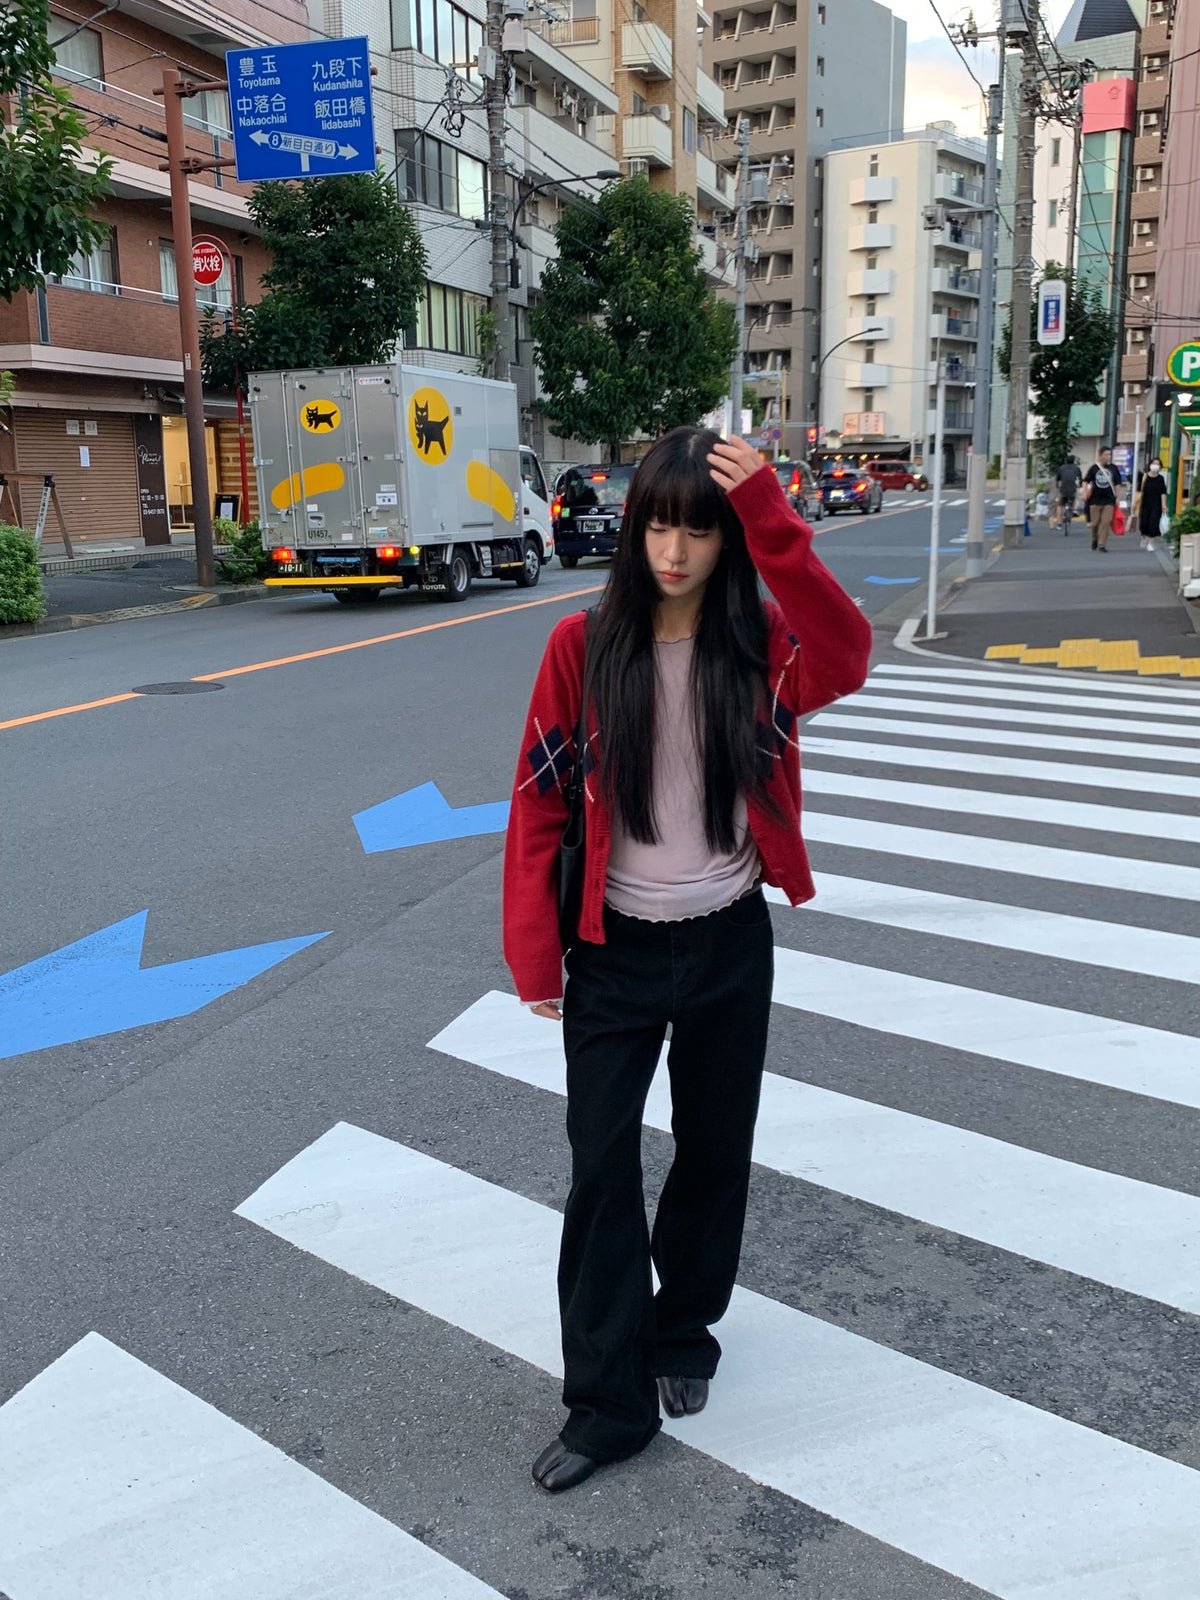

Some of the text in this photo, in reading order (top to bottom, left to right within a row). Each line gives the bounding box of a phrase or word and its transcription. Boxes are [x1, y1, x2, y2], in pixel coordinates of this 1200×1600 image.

[239, 54, 277, 76] 豊玉
[312, 56, 362, 80] 九段下
[238, 76, 281, 90] Toyotama
[313, 78, 363, 92] Kudanshita
[237, 93, 286, 115] 中落合
[314, 96, 366, 119] 飯田橋
[239, 113, 288, 127] Nakaochiai
[322, 117, 361, 130] Iidabashi
[271, 134, 279, 146] 8
[283, 136, 334, 154] 新目白通り
[193, 254, 220, 273] 消火栓
[1181, 351, 1200, 379] P
[308, 530, 328, 539] U1457
